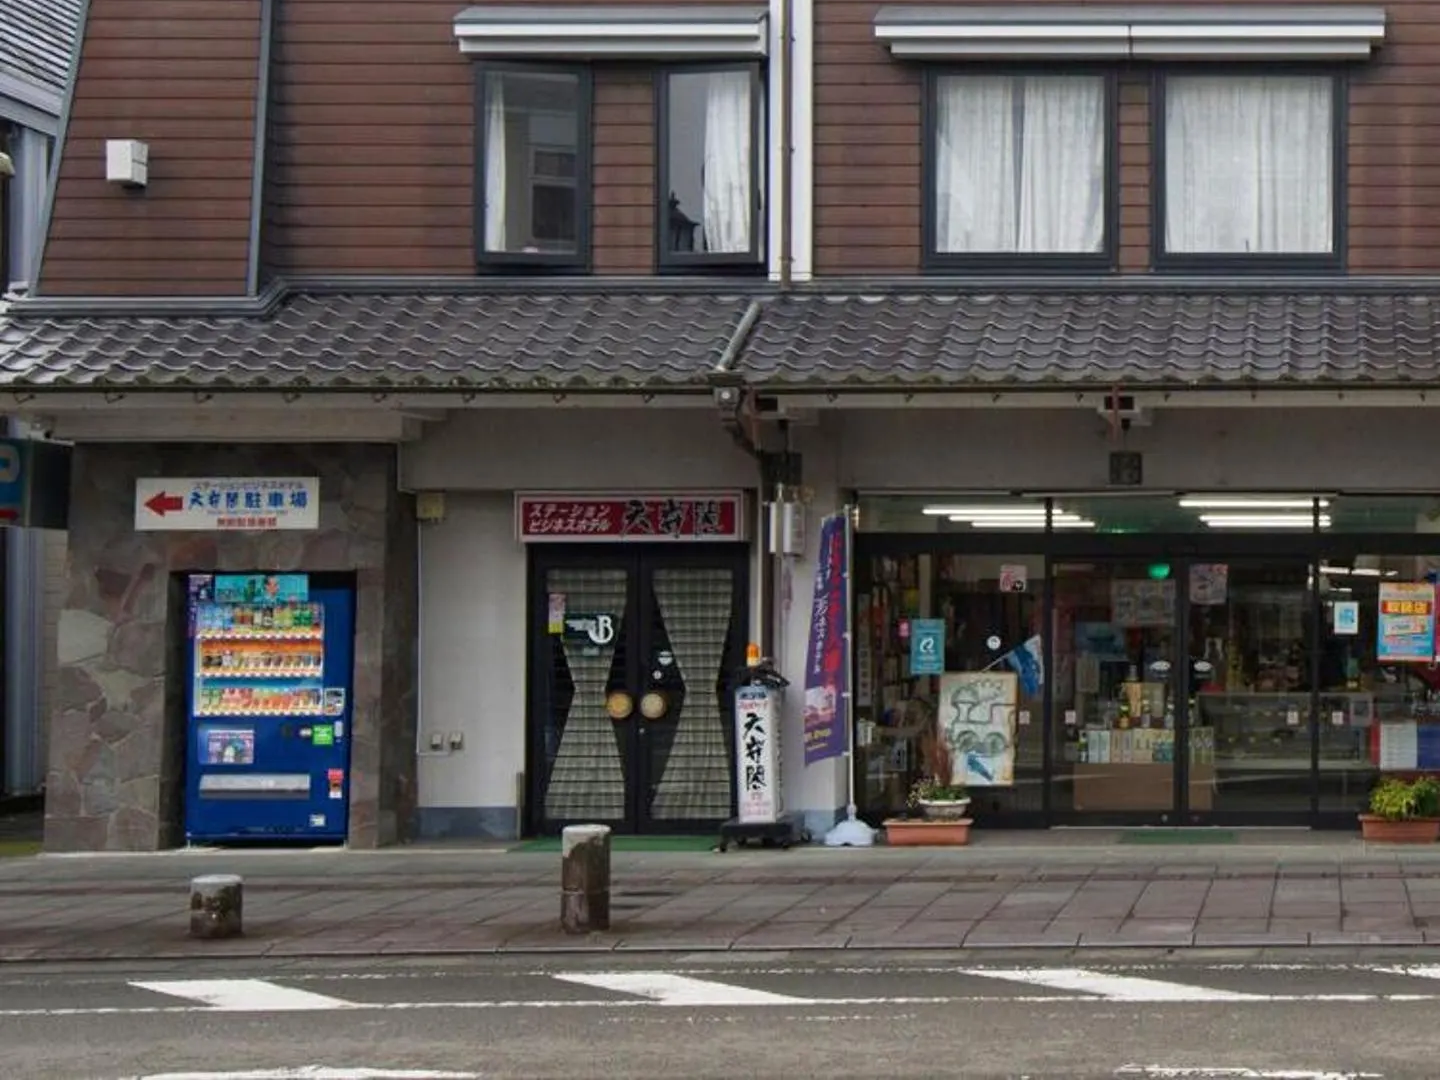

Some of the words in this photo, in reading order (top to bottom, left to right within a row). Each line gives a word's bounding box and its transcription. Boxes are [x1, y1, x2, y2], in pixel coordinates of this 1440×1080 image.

[529, 503, 611, 518] ステーション
[528, 518, 612, 533] ビジネスホテル
